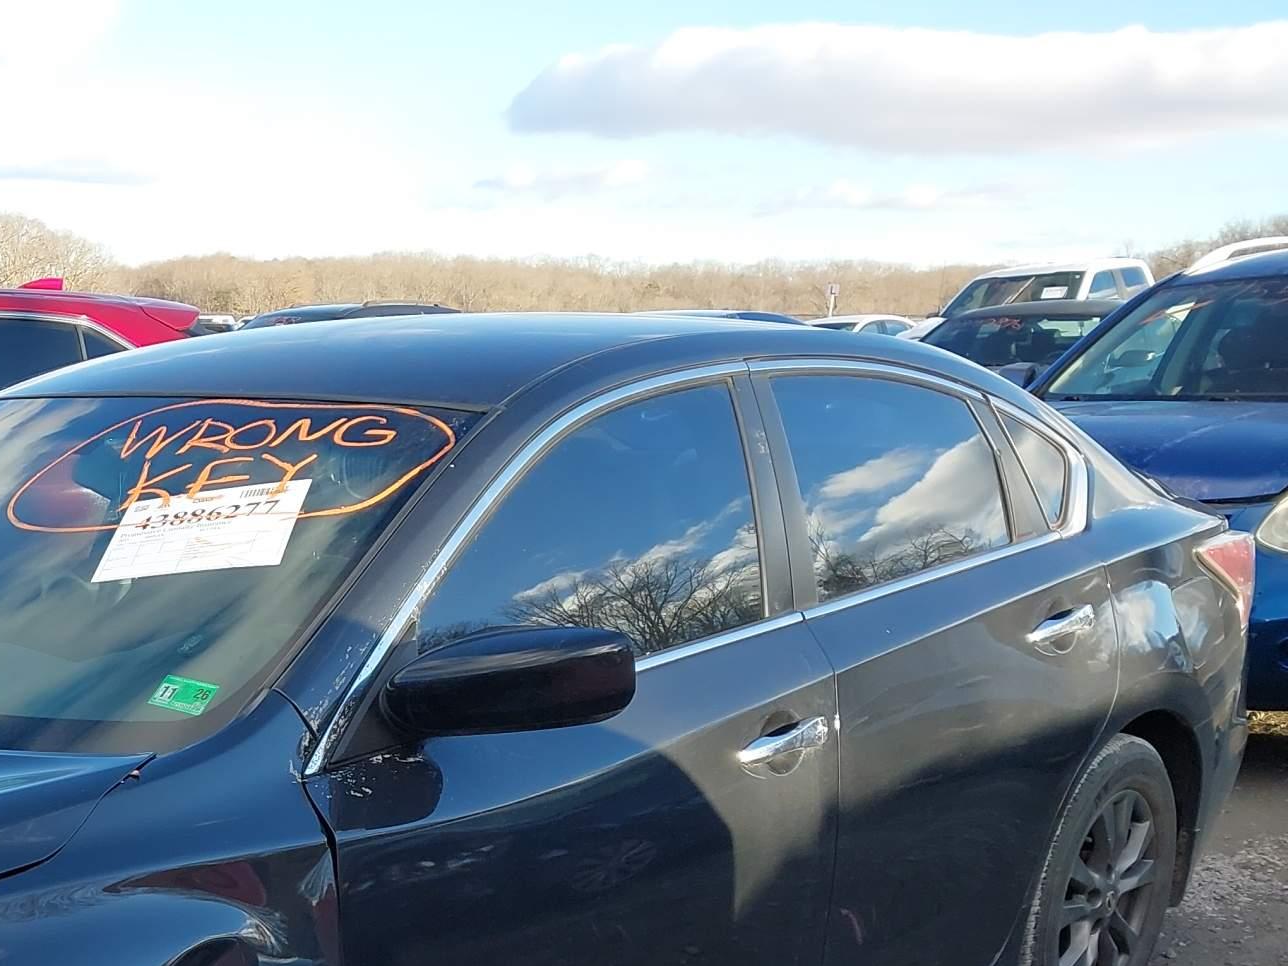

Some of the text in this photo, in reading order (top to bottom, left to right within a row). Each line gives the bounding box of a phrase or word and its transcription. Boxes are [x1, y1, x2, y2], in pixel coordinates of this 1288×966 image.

[120, 416, 397, 459] WRONG
[116, 453, 318, 512] KEY
[134, 499, 281, 531] 43886277
[159, 686, 178, 699] 11
